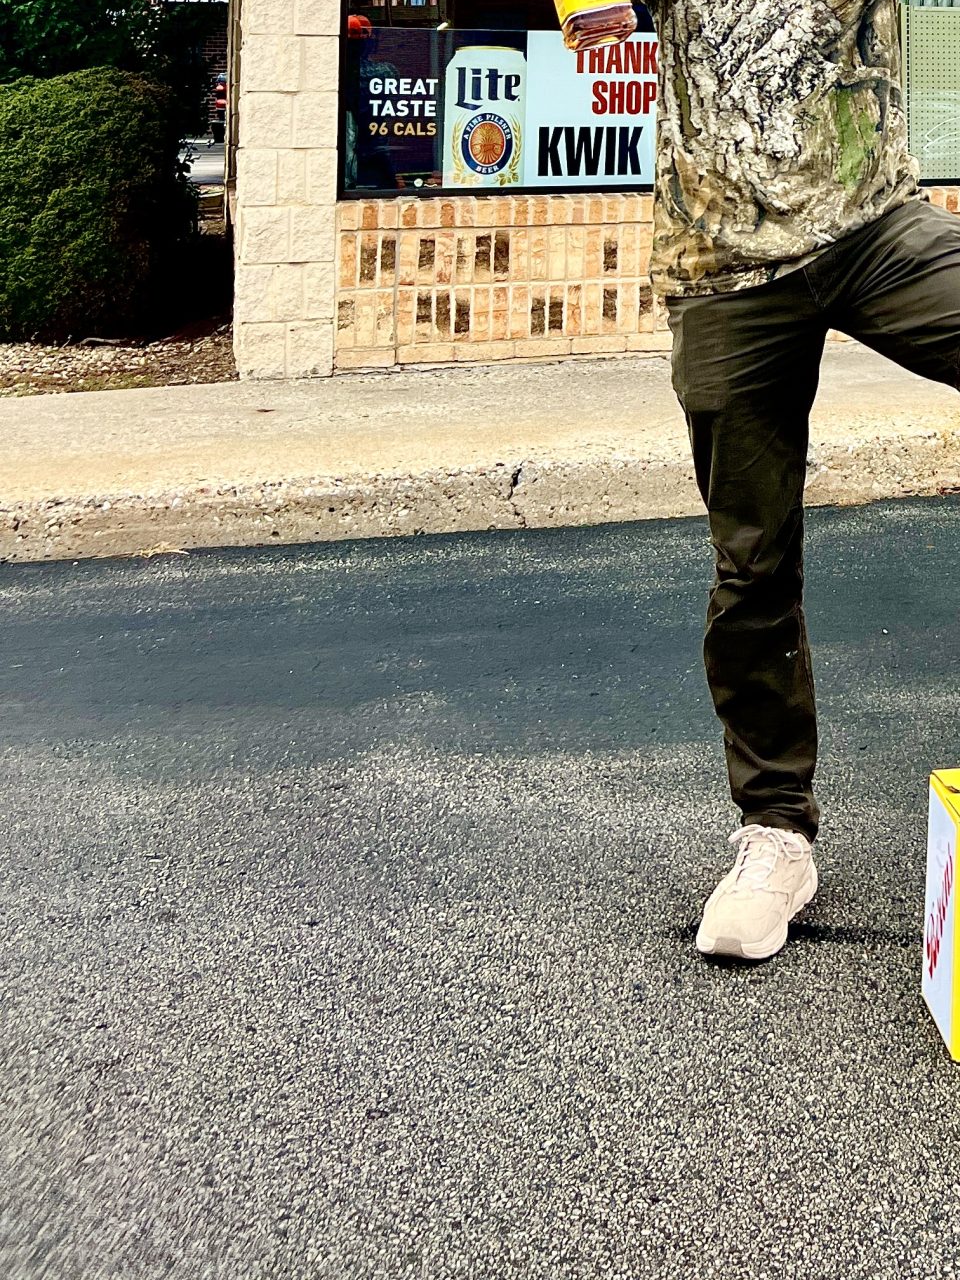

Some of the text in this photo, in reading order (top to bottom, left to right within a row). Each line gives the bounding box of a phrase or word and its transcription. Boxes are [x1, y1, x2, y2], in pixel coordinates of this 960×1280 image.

[369, 77, 439, 95] GREAT
[454, 66, 521, 111] Lite
[369, 99, 437, 117] TASTE
[368, 121, 437, 136] 96 CALS
[465, 114, 484, 133] FINE
[485, 114, 513, 140] PILSNER
[537, 126, 644, 177] KWIK
[475, 165, 500, 174] BEER
